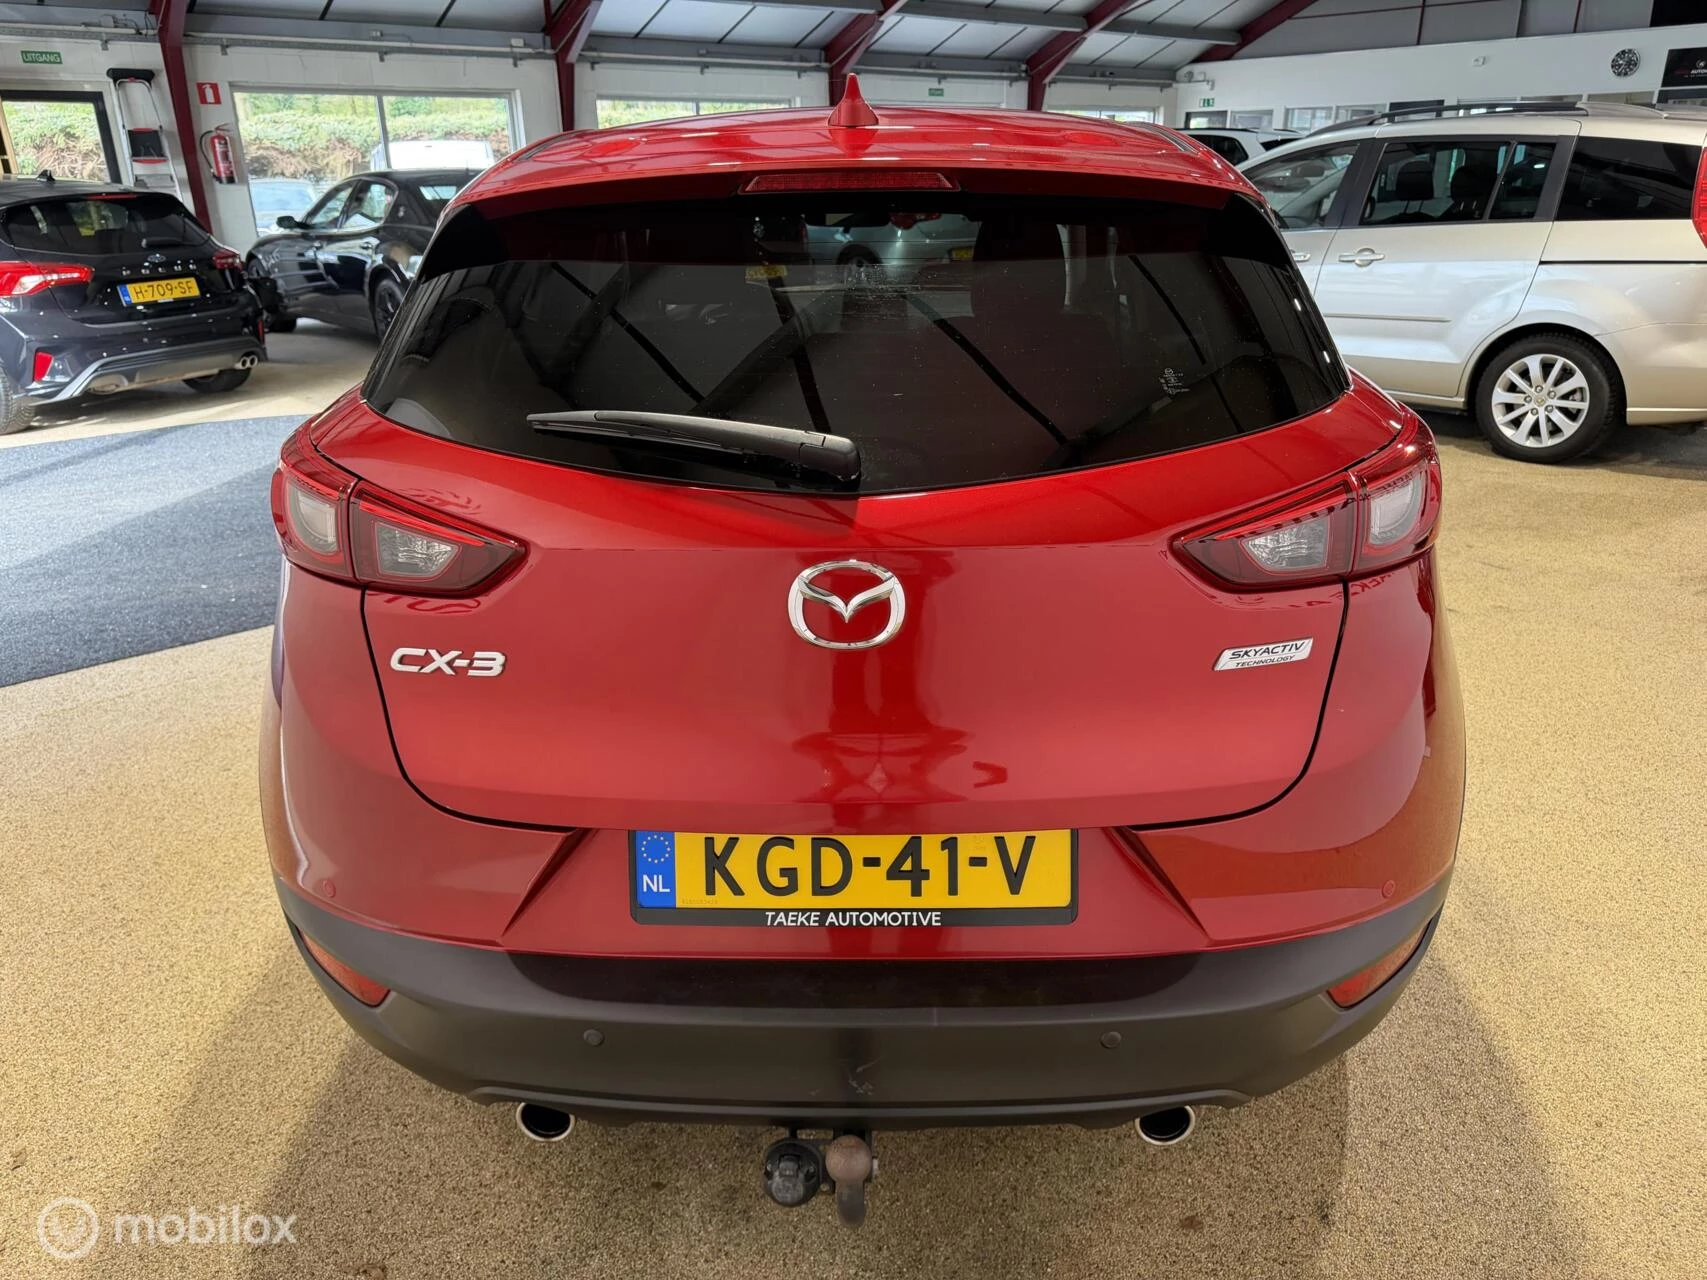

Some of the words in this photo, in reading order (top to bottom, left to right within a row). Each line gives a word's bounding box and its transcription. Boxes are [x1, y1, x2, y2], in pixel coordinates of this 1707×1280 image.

[22, 52, 61, 63] UITGANG
[133, 280, 193, 299] H-709-SF
[1229, 641, 1305, 660] SKYACTIV
[390, 647, 506, 677] CX-3
[1235, 655, 1296, 668] TECHNOLOGY
[704, 835, 1037, 897] KGD-41-V
[642, 874, 671, 893] NL
[765, 911, 821, 927] TAEKE
[825, 910, 942, 927] AUTOMOTIVE
